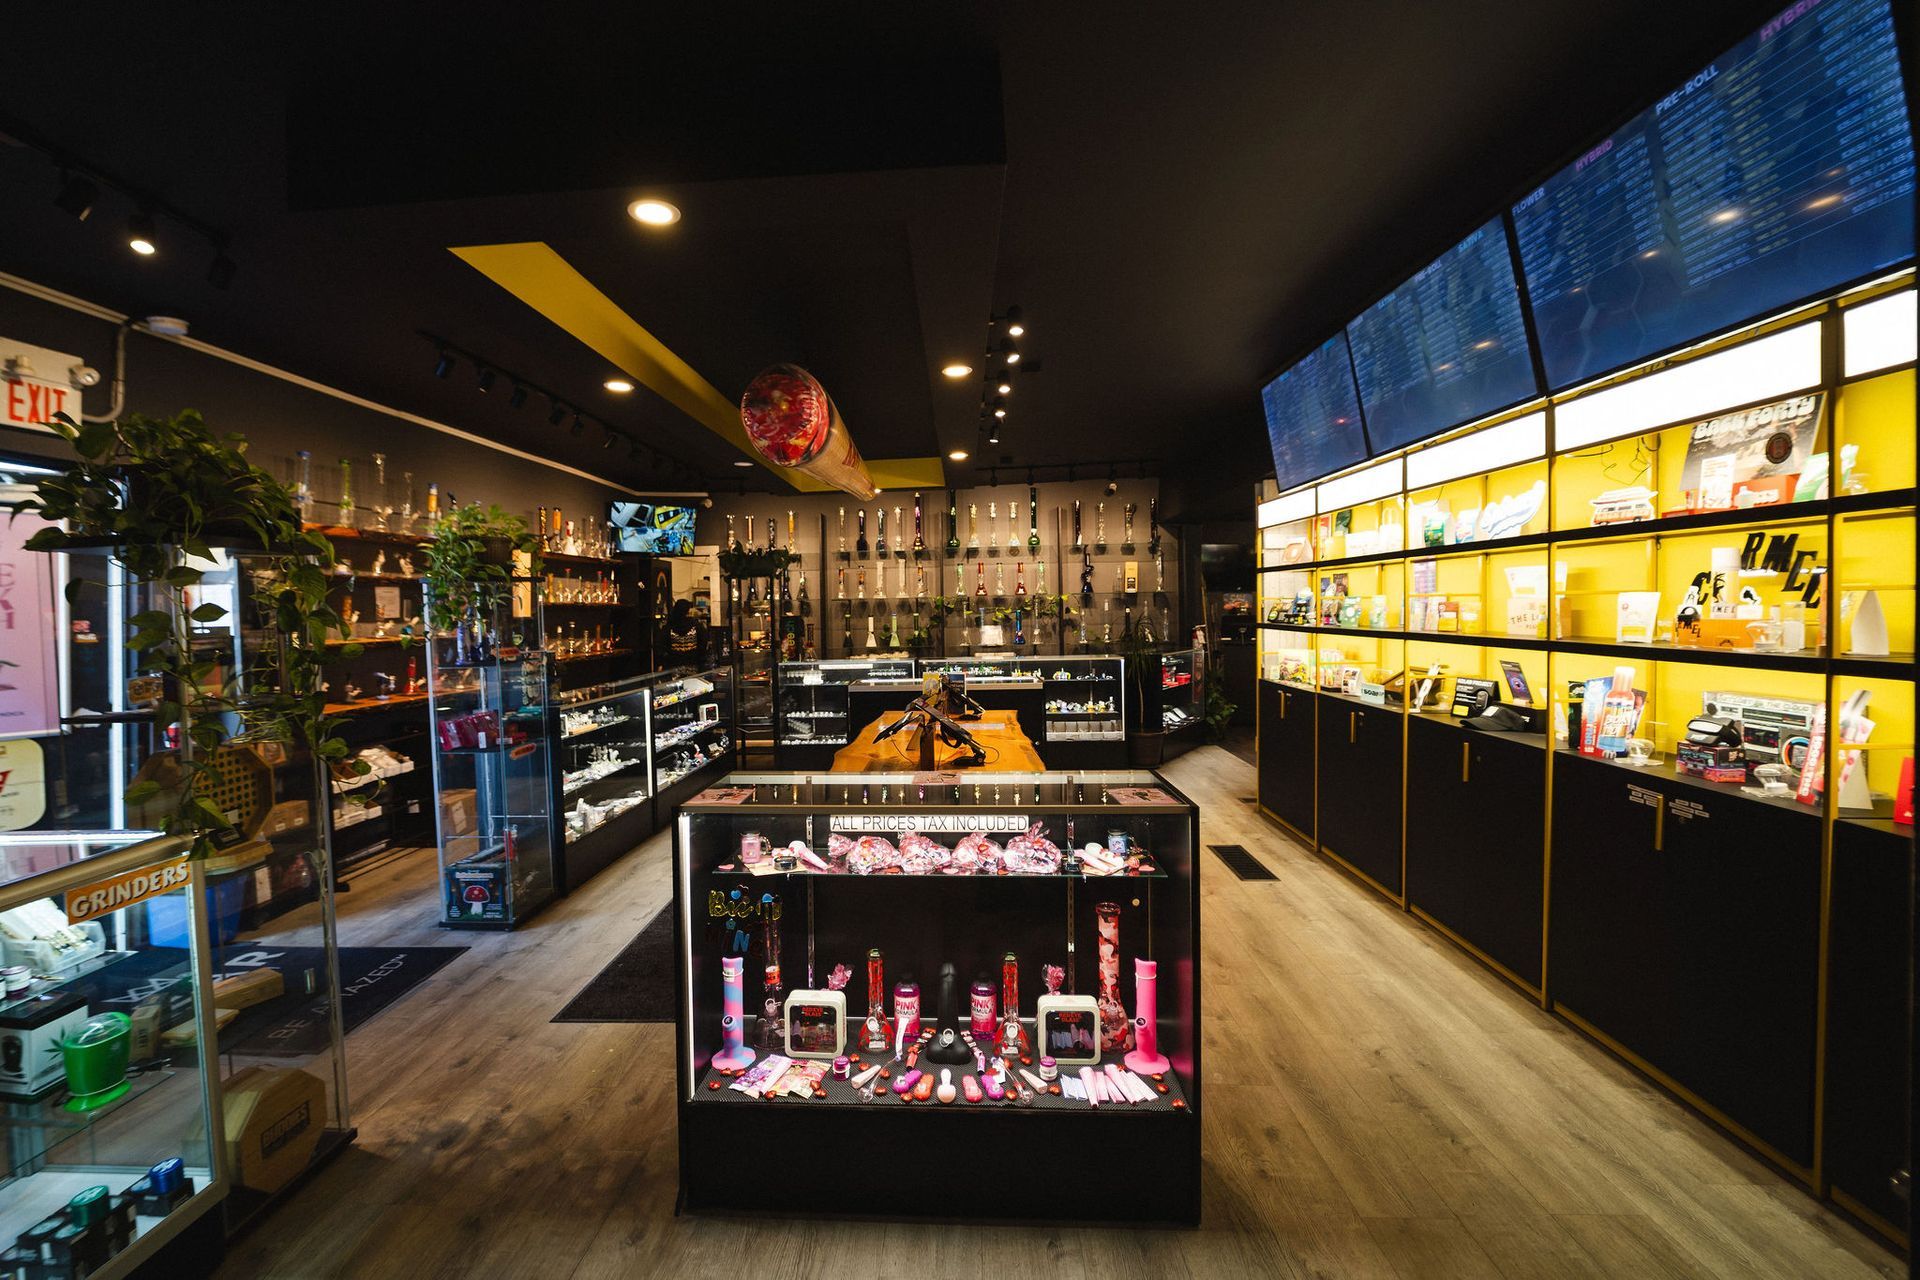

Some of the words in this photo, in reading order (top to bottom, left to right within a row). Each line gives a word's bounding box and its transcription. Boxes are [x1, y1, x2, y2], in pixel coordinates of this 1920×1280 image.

[1655, 64, 1719, 116] PRE-ROLL
[1575, 138, 1614, 171] HYBRID
[1511, 187, 1545, 217] FLOWER
[8, 378, 67, 424] EXIT
[1747, 395, 1817, 427] FORTY
[832, 816, 857, 830] ALL
[862, 815, 916, 831] PRICES
[921, 815, 947, 830] TAX
[952, 815, 1027, 831] INCLUDED
[70, 862, 188, 918] GRINDERS
[895, 1000, 916, 1011] PINK
